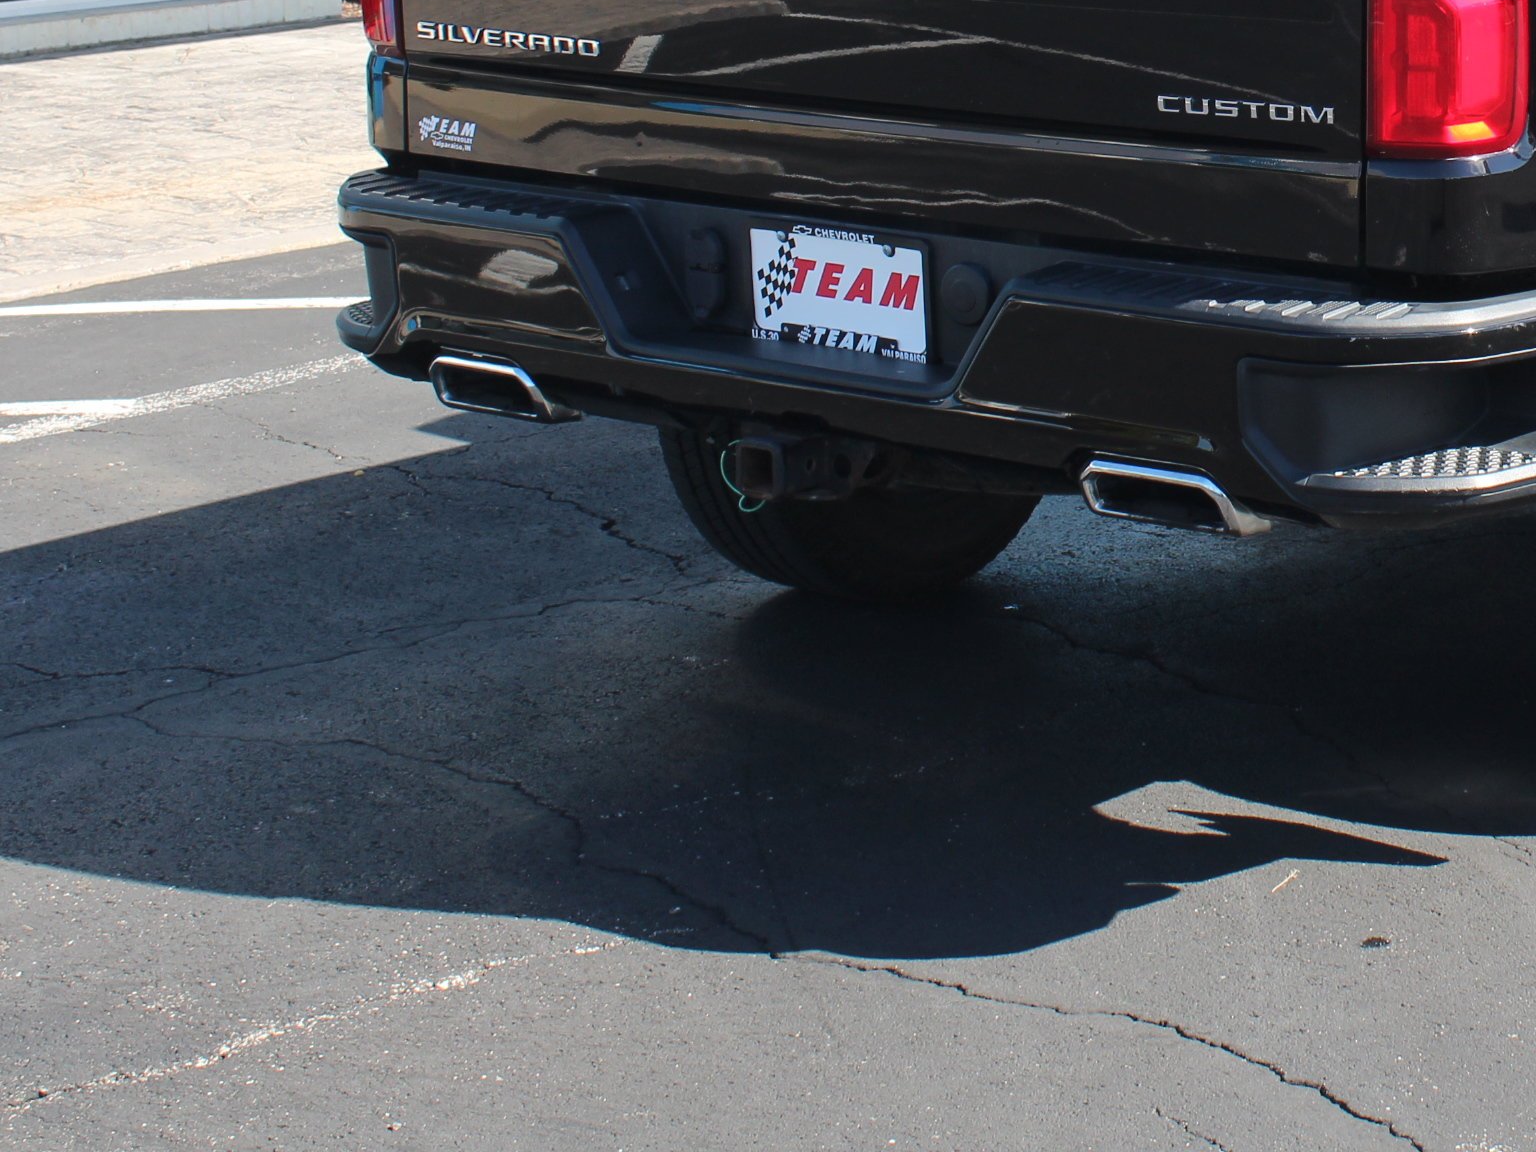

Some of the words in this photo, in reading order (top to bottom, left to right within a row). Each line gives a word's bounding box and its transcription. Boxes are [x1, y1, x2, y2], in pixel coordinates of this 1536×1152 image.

[416, 20, 601, 58] SILVERADO
[1156, 94, 1335, 126] CUSTOM
[430, 115, 477, 139] TEAM
[444, 134, 473, 145] CHEVROLET
[814, 227, 876, 244] CHEVROLET
[791, 257, 921, 311] TEAM
[812, 326, 880, 354] TEAM
